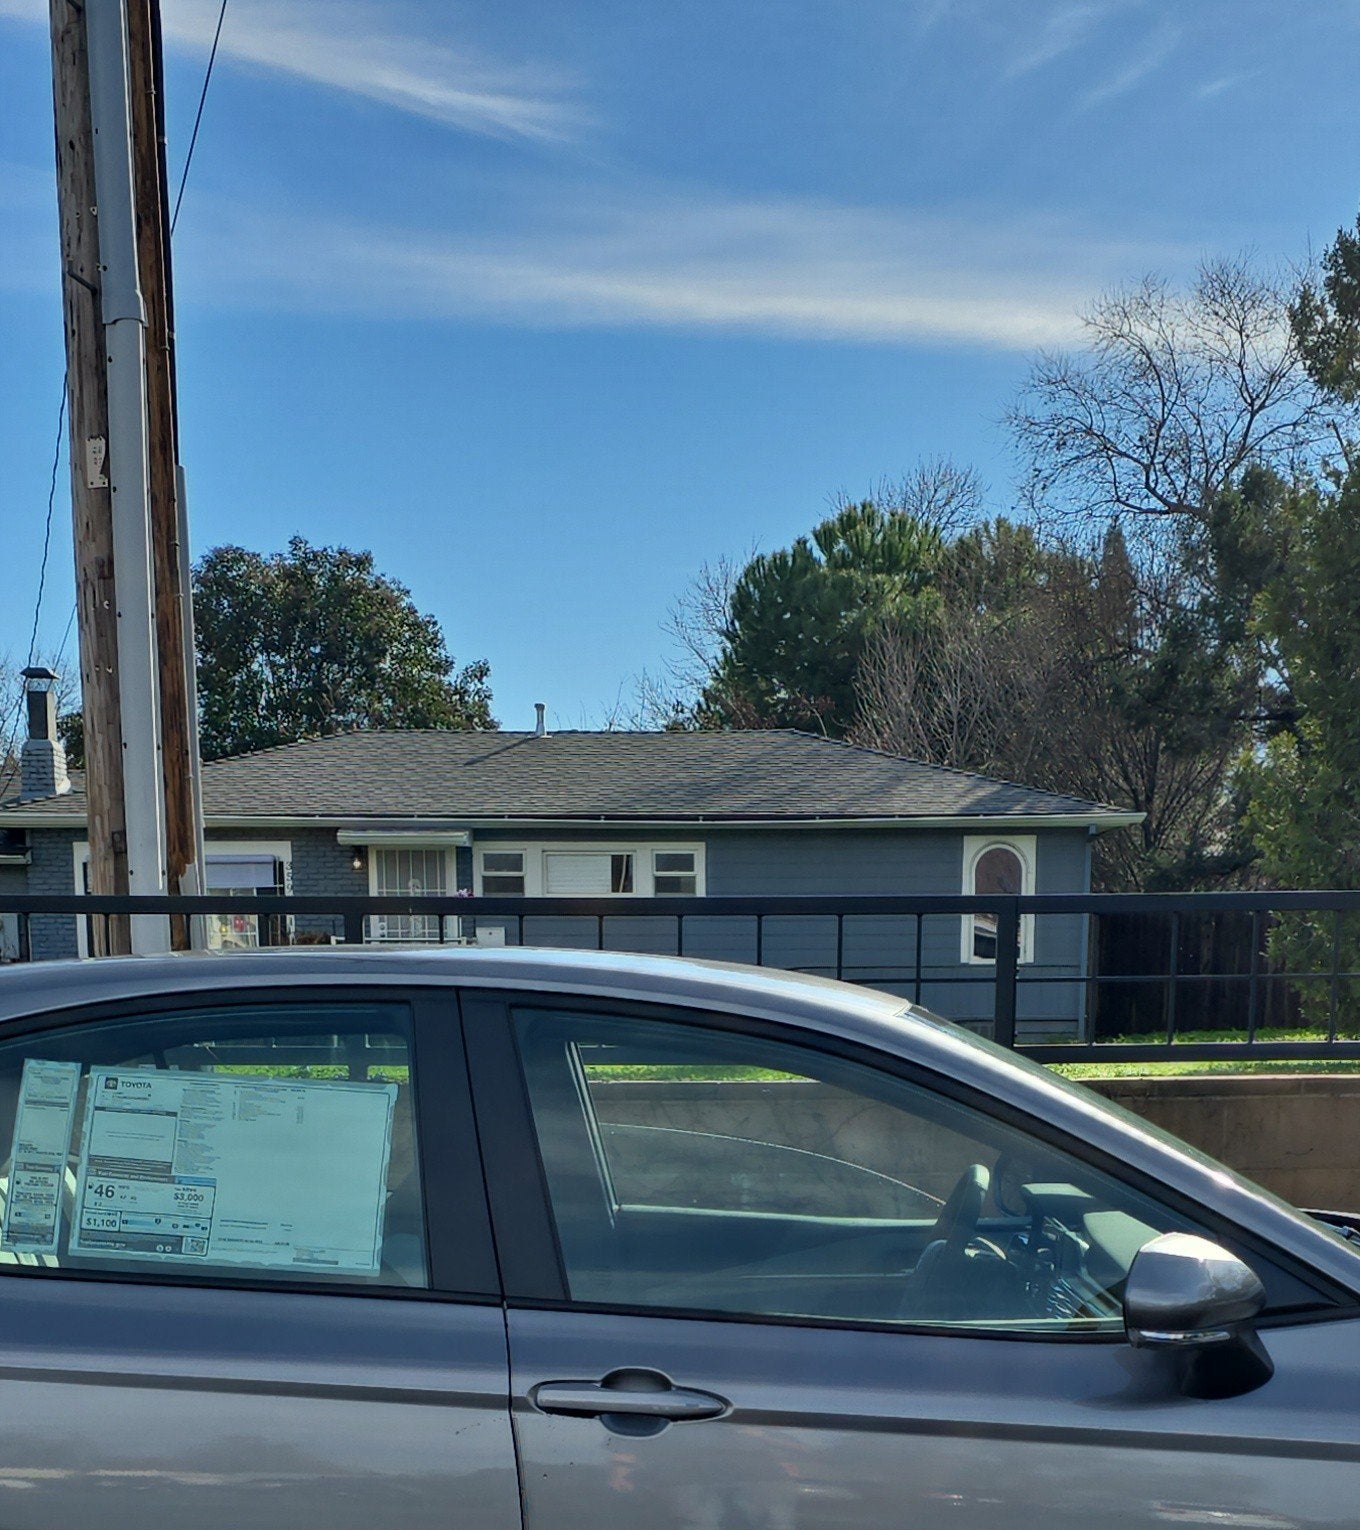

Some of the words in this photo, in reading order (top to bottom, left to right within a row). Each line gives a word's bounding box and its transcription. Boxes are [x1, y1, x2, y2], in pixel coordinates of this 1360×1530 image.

[121, 1080, 152, 1089] TOYOTA
[94, 1184, 115, 1199] 46
[173, 1192, 204, 1203] $3,000
[86, 1218, 117, 1228] $1,100
